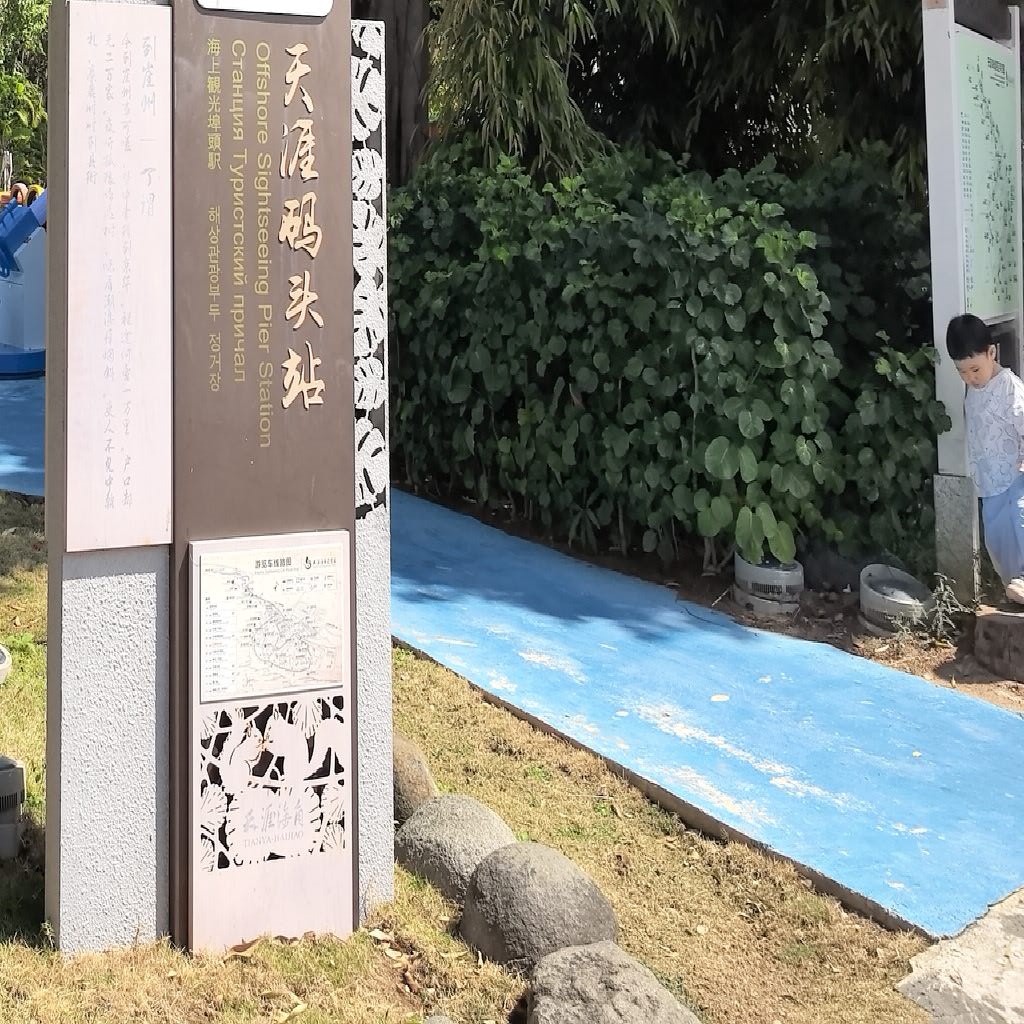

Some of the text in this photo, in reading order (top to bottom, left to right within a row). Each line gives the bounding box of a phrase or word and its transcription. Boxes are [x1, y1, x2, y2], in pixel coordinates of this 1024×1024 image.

[229, 39, 248, 384] Станция Туристский причал
[254, 41, 274, 448] Offshore Sightseeing Pier Station
[277, 43, 326, 411] 天涯码头站
